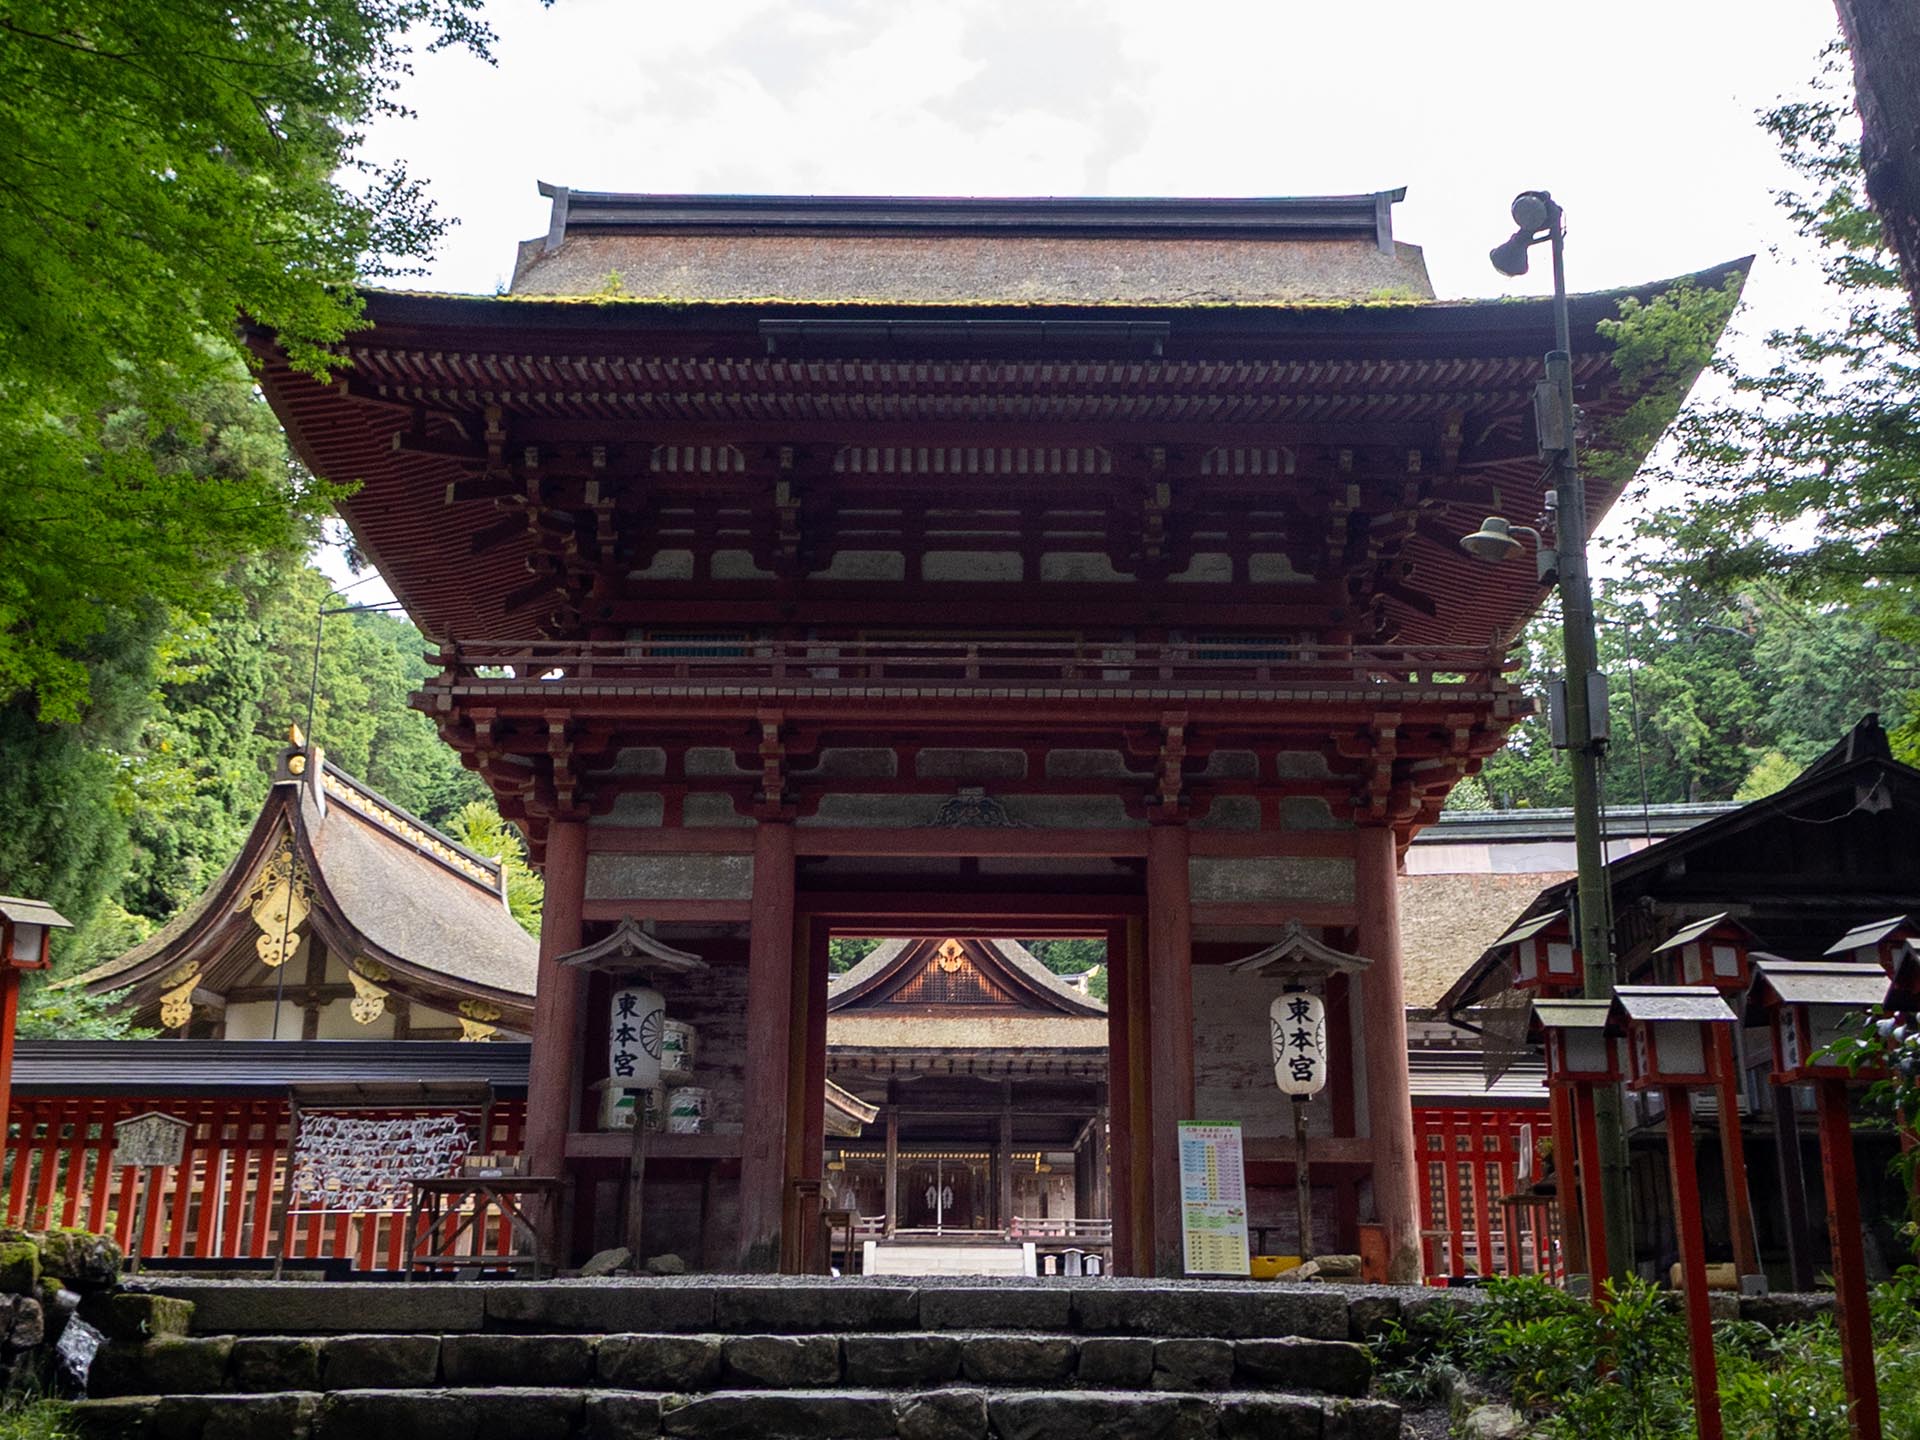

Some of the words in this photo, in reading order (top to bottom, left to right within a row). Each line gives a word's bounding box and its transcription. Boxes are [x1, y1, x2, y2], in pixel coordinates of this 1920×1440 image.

[614, 992, 641, 1077] 東本宮
[1286, 997, 1316, 1082] 東本宮
